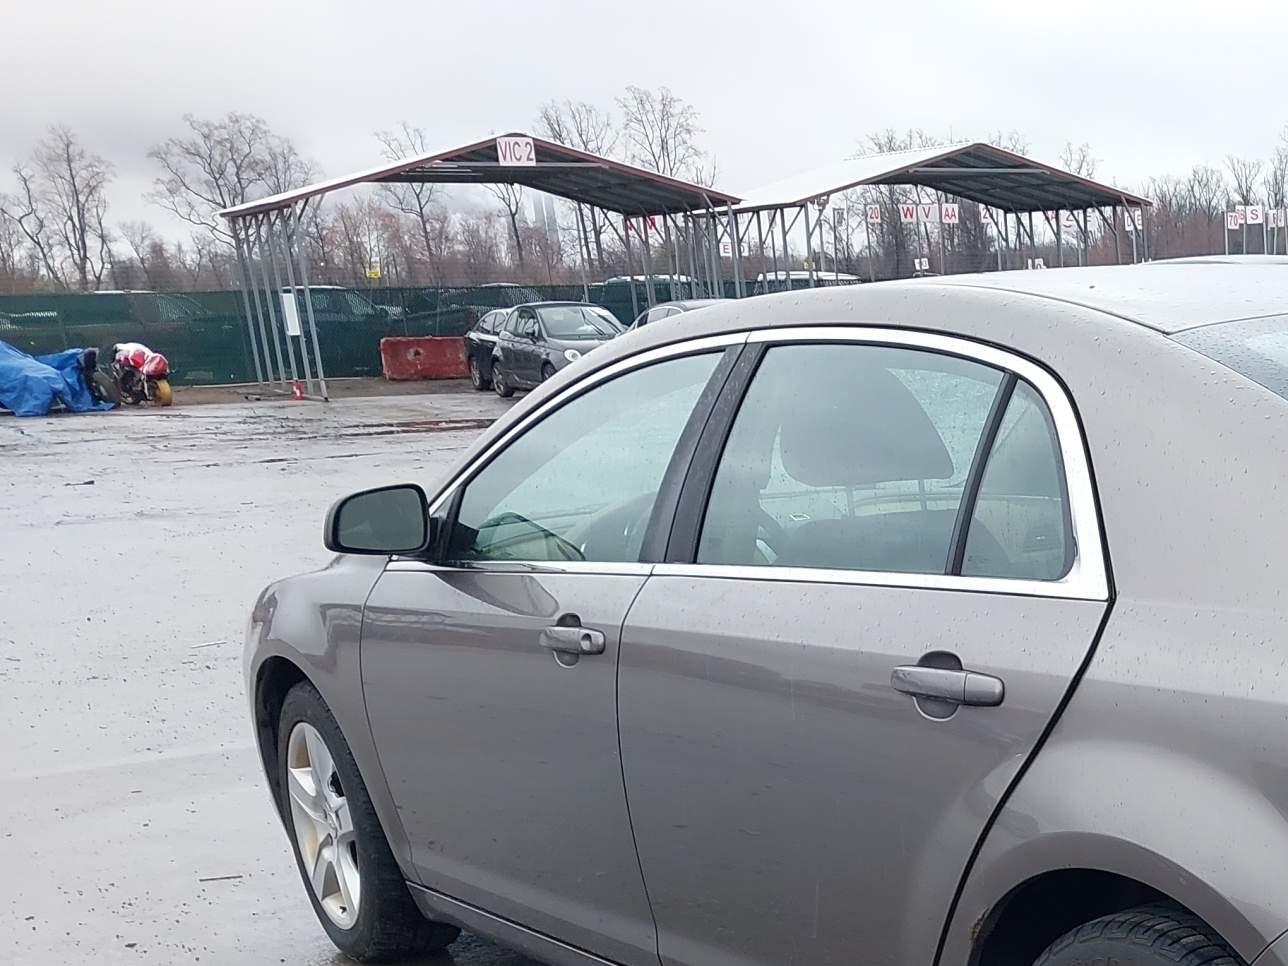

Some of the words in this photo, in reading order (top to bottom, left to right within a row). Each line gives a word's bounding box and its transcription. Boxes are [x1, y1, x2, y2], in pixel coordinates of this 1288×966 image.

[497, 141, 522, 162] VIC
[524, 141, 534, 162] 2
[868, 206, 879, 220] 20
[901, 206, 914, 219] W
[922, 206, 932, 219] V
[943, 208, 957, 220] AA
[1250, 209, 1259, 220] S
